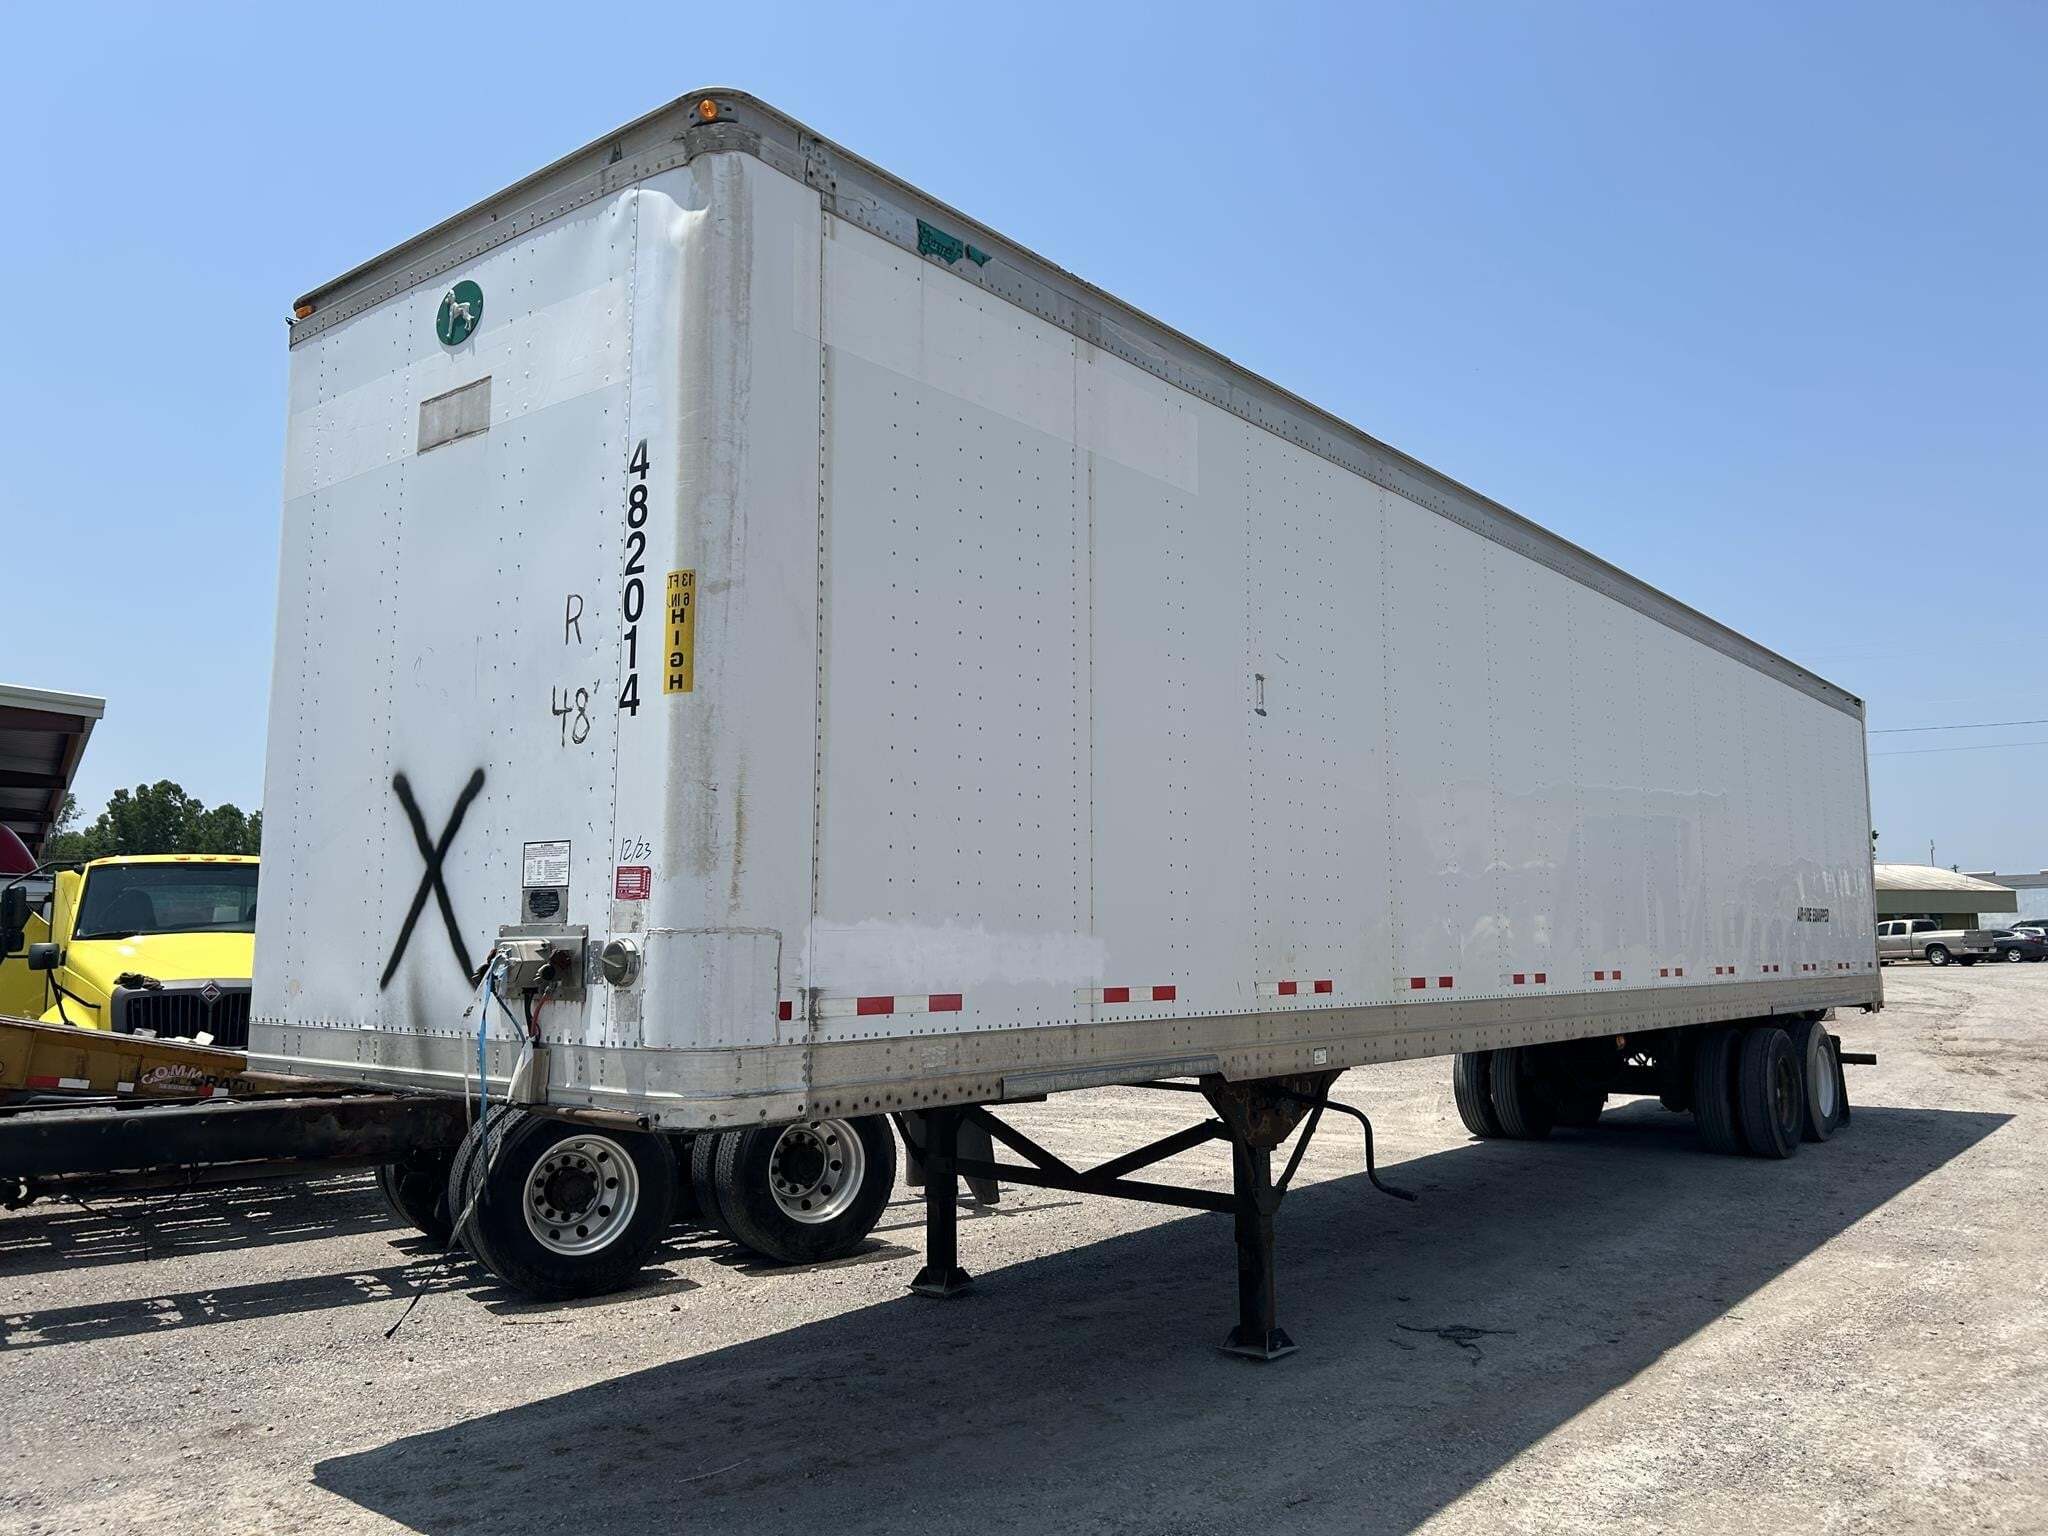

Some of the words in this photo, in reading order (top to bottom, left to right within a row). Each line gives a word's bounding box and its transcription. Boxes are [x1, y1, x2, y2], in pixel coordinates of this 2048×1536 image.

[618, 439, 651, 717] 482014
[565, 593, 584, 646] R
[619, 835, 653, 863] 12/23
